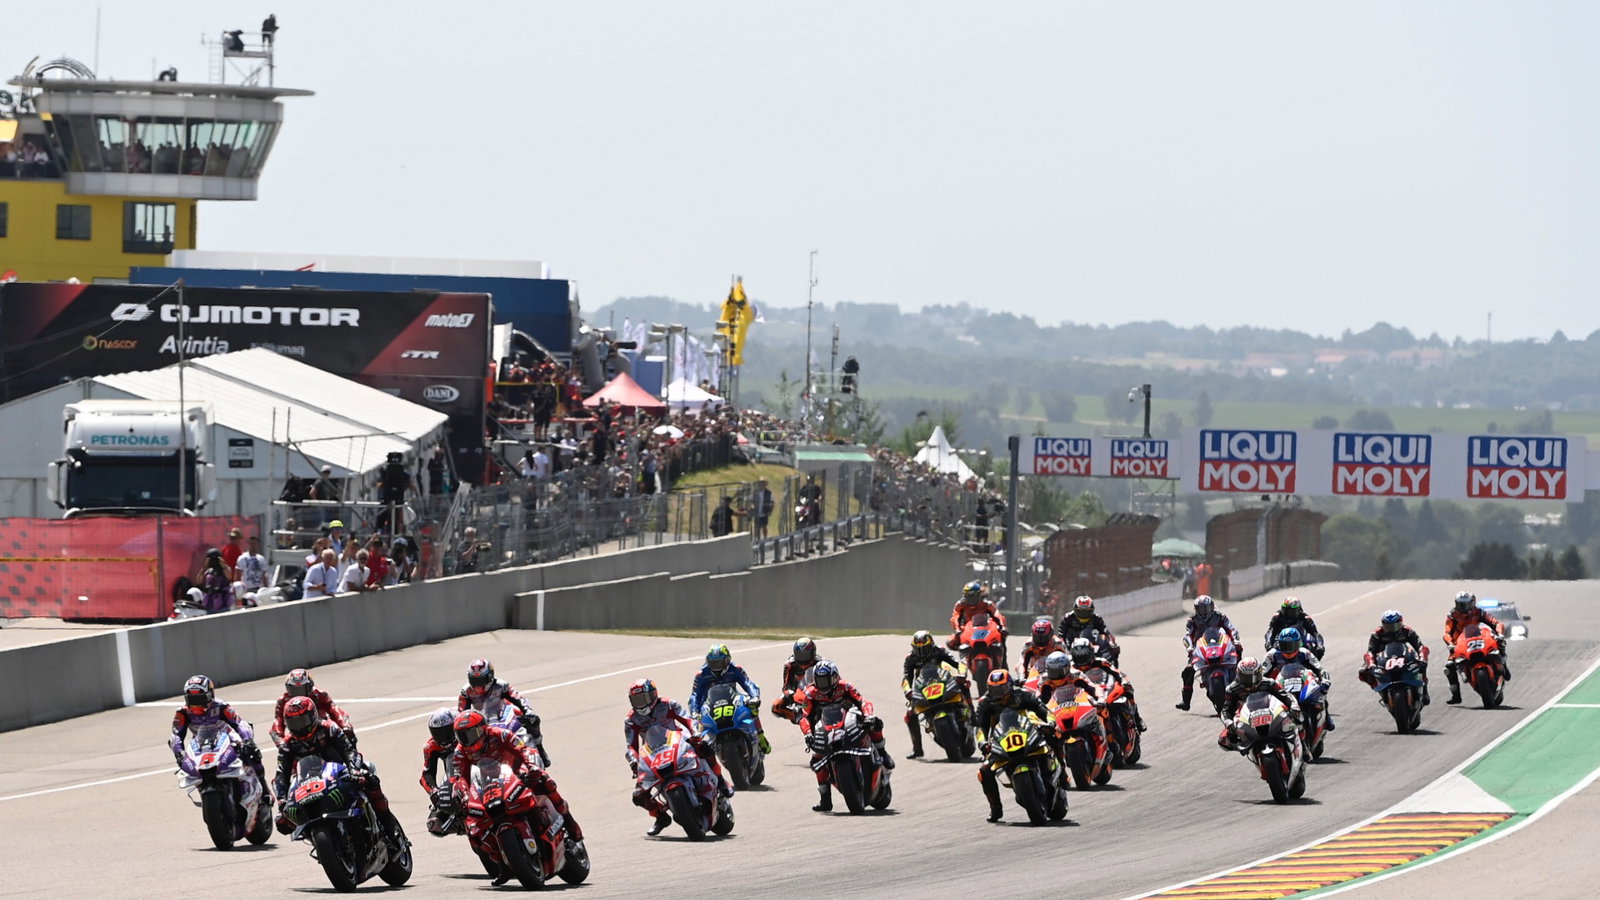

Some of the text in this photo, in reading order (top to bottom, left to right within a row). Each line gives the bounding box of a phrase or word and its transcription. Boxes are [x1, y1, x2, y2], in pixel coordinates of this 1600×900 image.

[160, 303, 360, 327] QJMOTOR
[159, 335, 229, 354] Avintia
[91, 434, 170, 446] PETRONAS
[1037, 439, 1089, 456] LIQUI
[1204, 432, 1293, 462] LIQUI
[1113, 441, 1167, 458] LIQUI
[1338, 434, 1427, 464] LIQUI
[1472, 438, 1563, 468] LIQUI
[1036, 457, 1090, 474] MOLY
[1112, 459, 1167, 476] MOLY
[1203, 462, 1295, 491] MOLY
[1337, 465, 1429, 494] MOLY
[1472, 468, 1564, 498] MOLY
[1466, 640, 1485, 653] 25
[1385, 657, 1405, 671] 04
[713, 705, 734, 721] 36
[1251, 714, 1272, 728] 30
[1005, 734, 1024, 750] 10
[650, 749, 674, 769] 49
[294, 781, 326, 803] 20
[483, 788, 502, 804] 63
